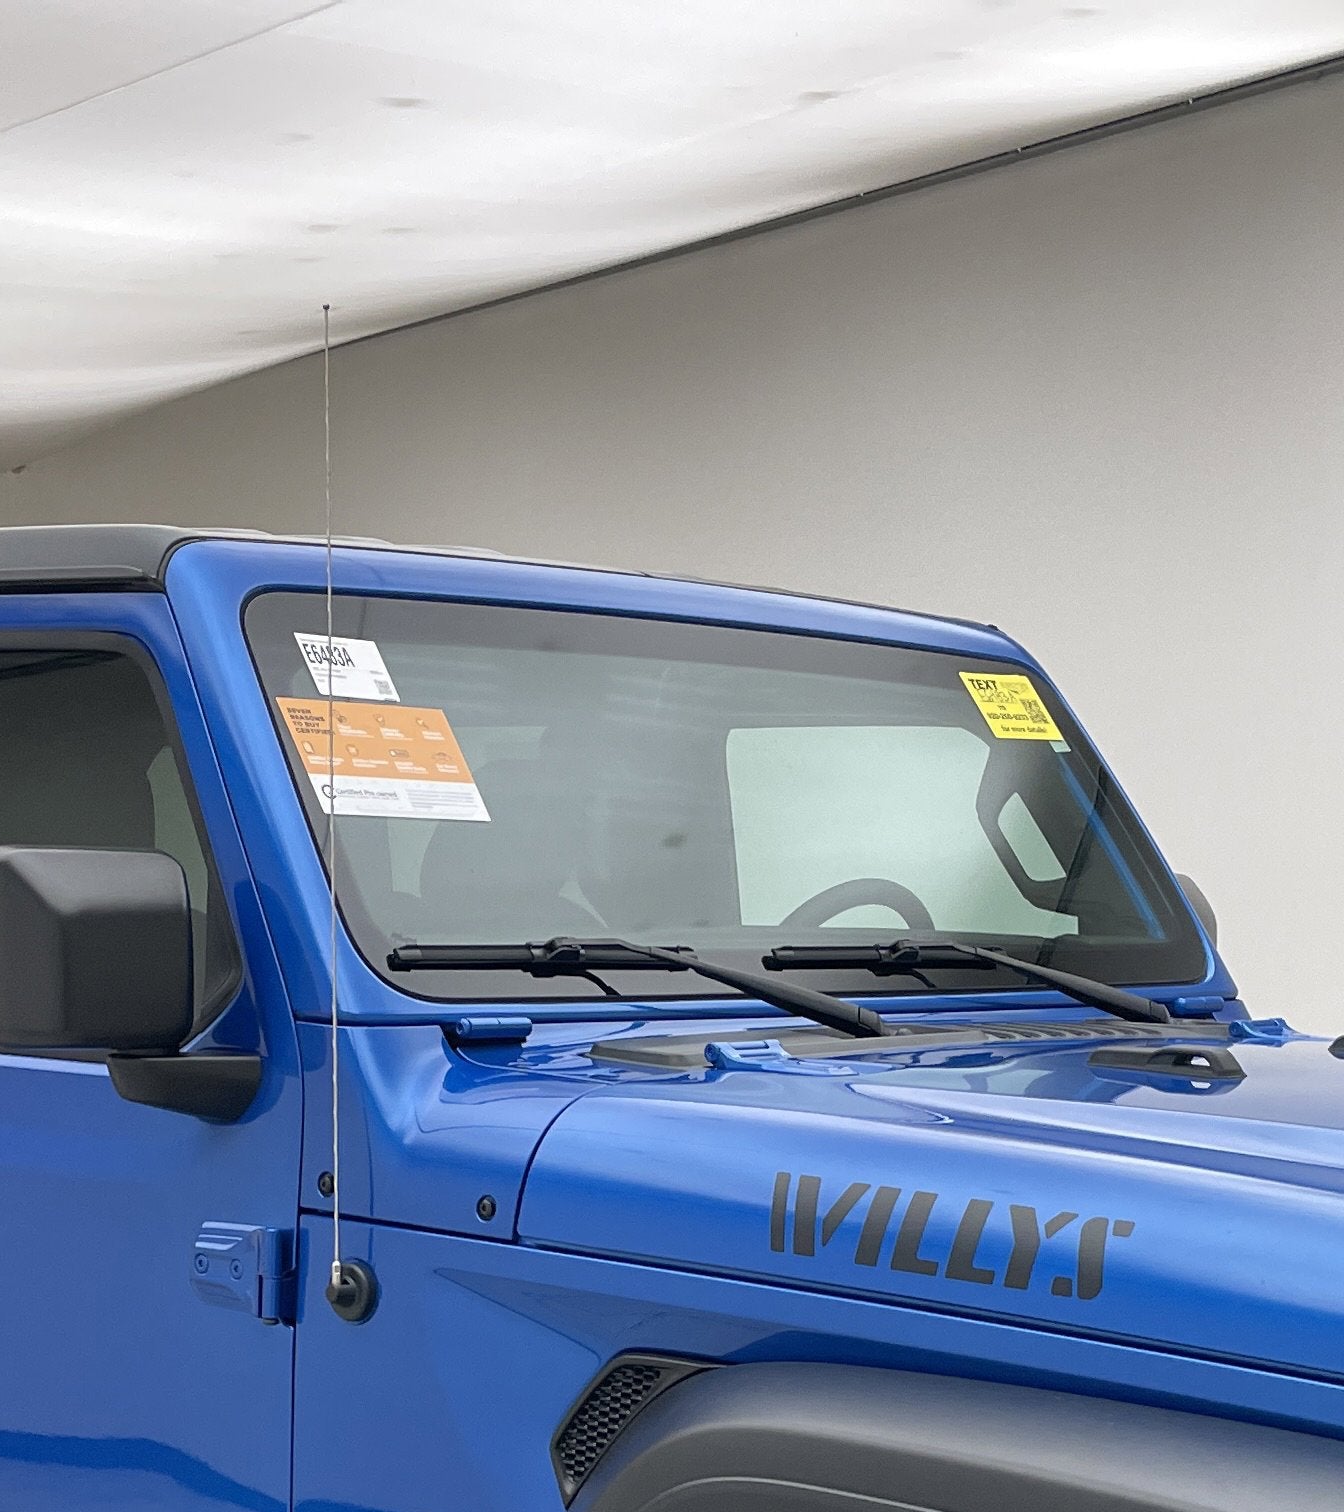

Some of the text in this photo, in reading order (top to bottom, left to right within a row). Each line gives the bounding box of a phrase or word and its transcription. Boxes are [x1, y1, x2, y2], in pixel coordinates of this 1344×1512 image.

[968, 678, 998, 690] TEXT
[289, 714, 326, 722] REASONS
[770, 1171, 1136, 1301] WILLYS
